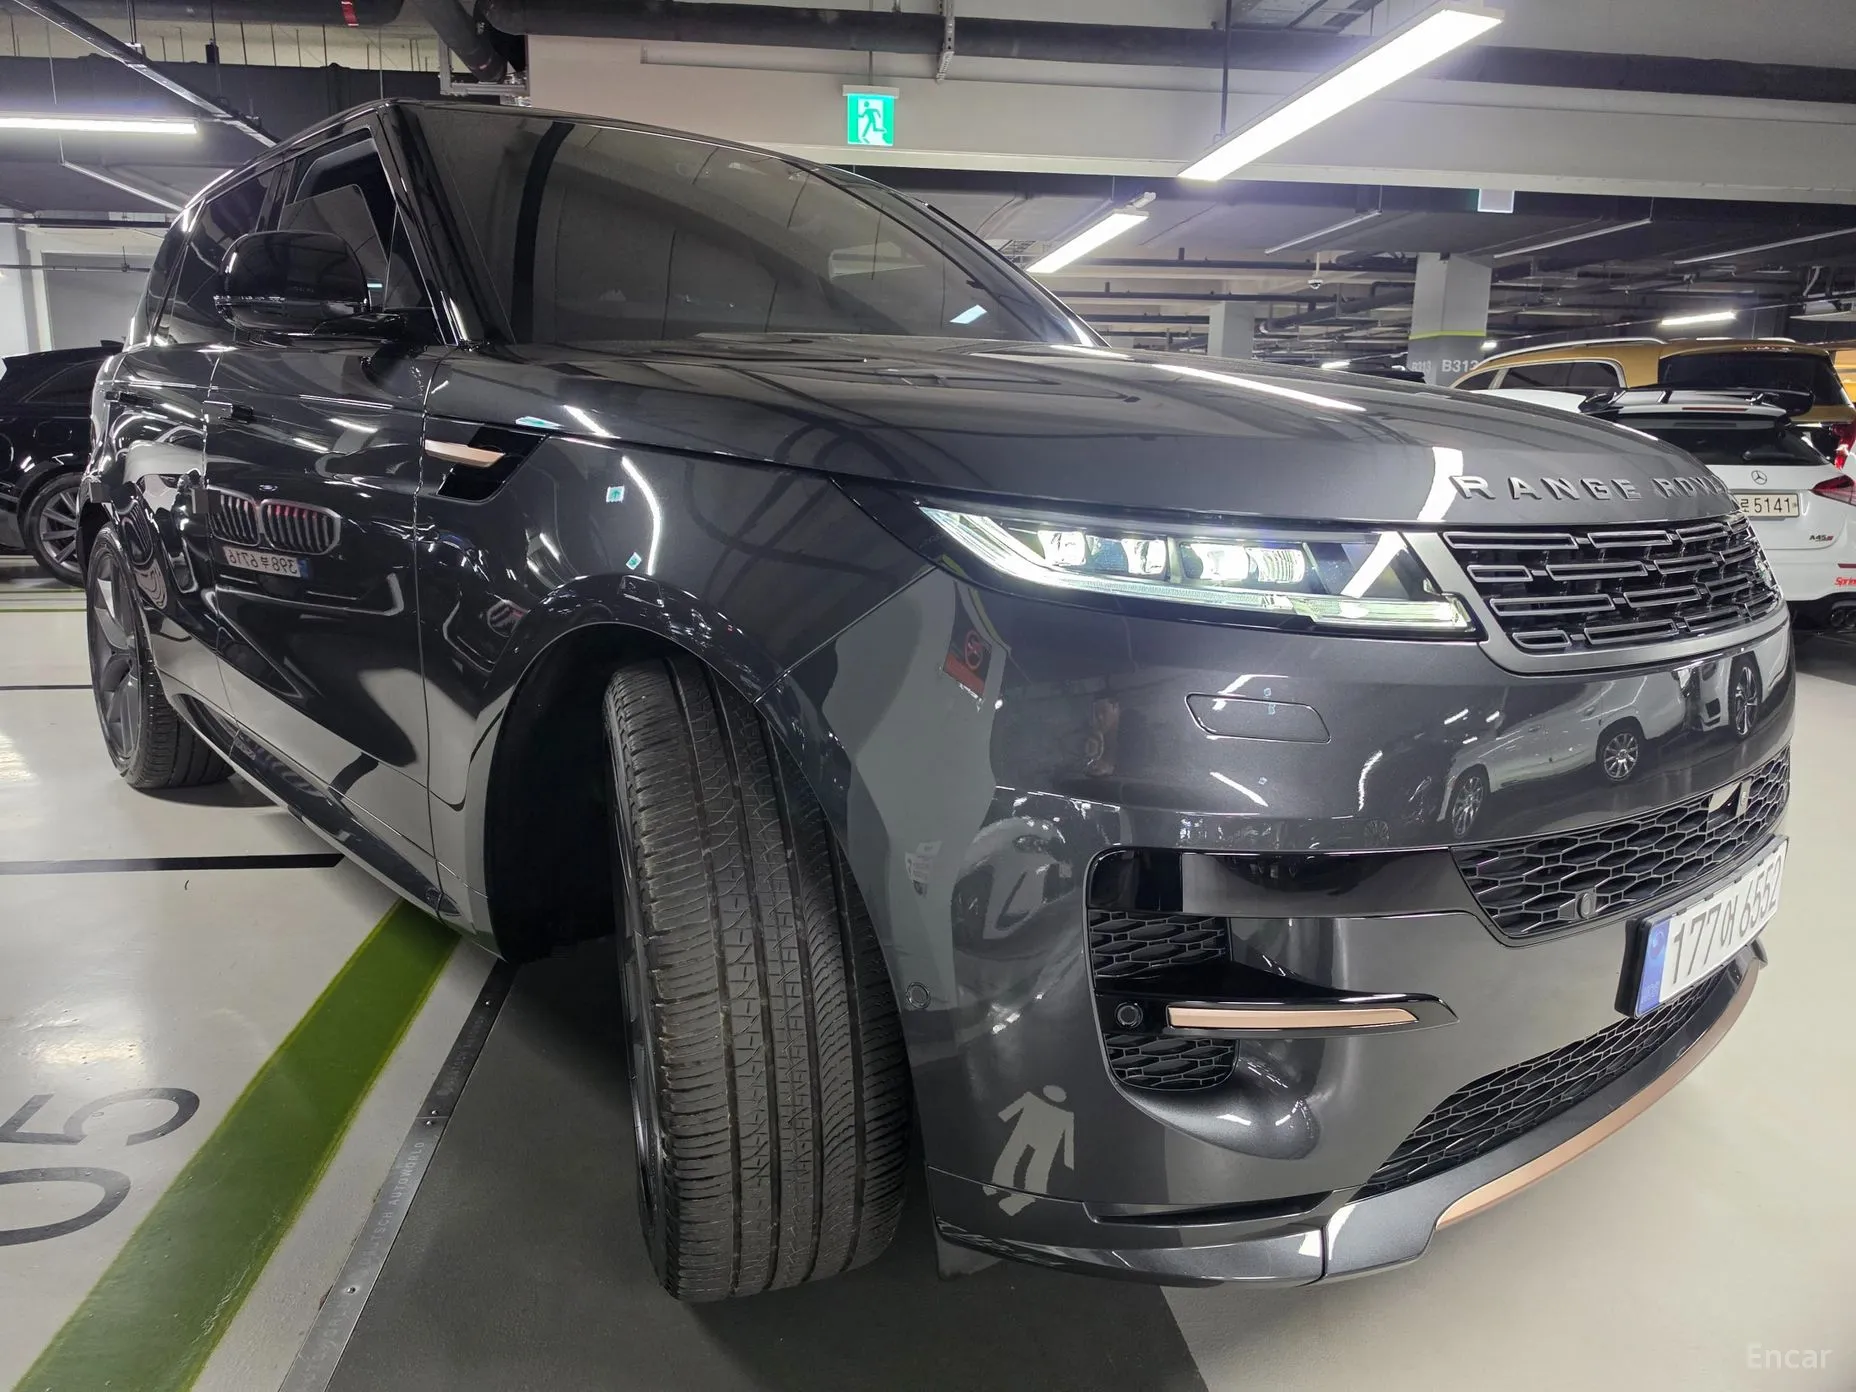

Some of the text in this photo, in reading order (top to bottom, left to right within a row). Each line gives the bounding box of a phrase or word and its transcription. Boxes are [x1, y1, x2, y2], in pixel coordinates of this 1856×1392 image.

[1449, 475, 1728, 500] RANGE ROV
[1754, 497, 1791, 513] 5141
[1673, 854, 1782, 985] 177어 6552
[388, 1141, 425, 1206] AUTOWORLD
